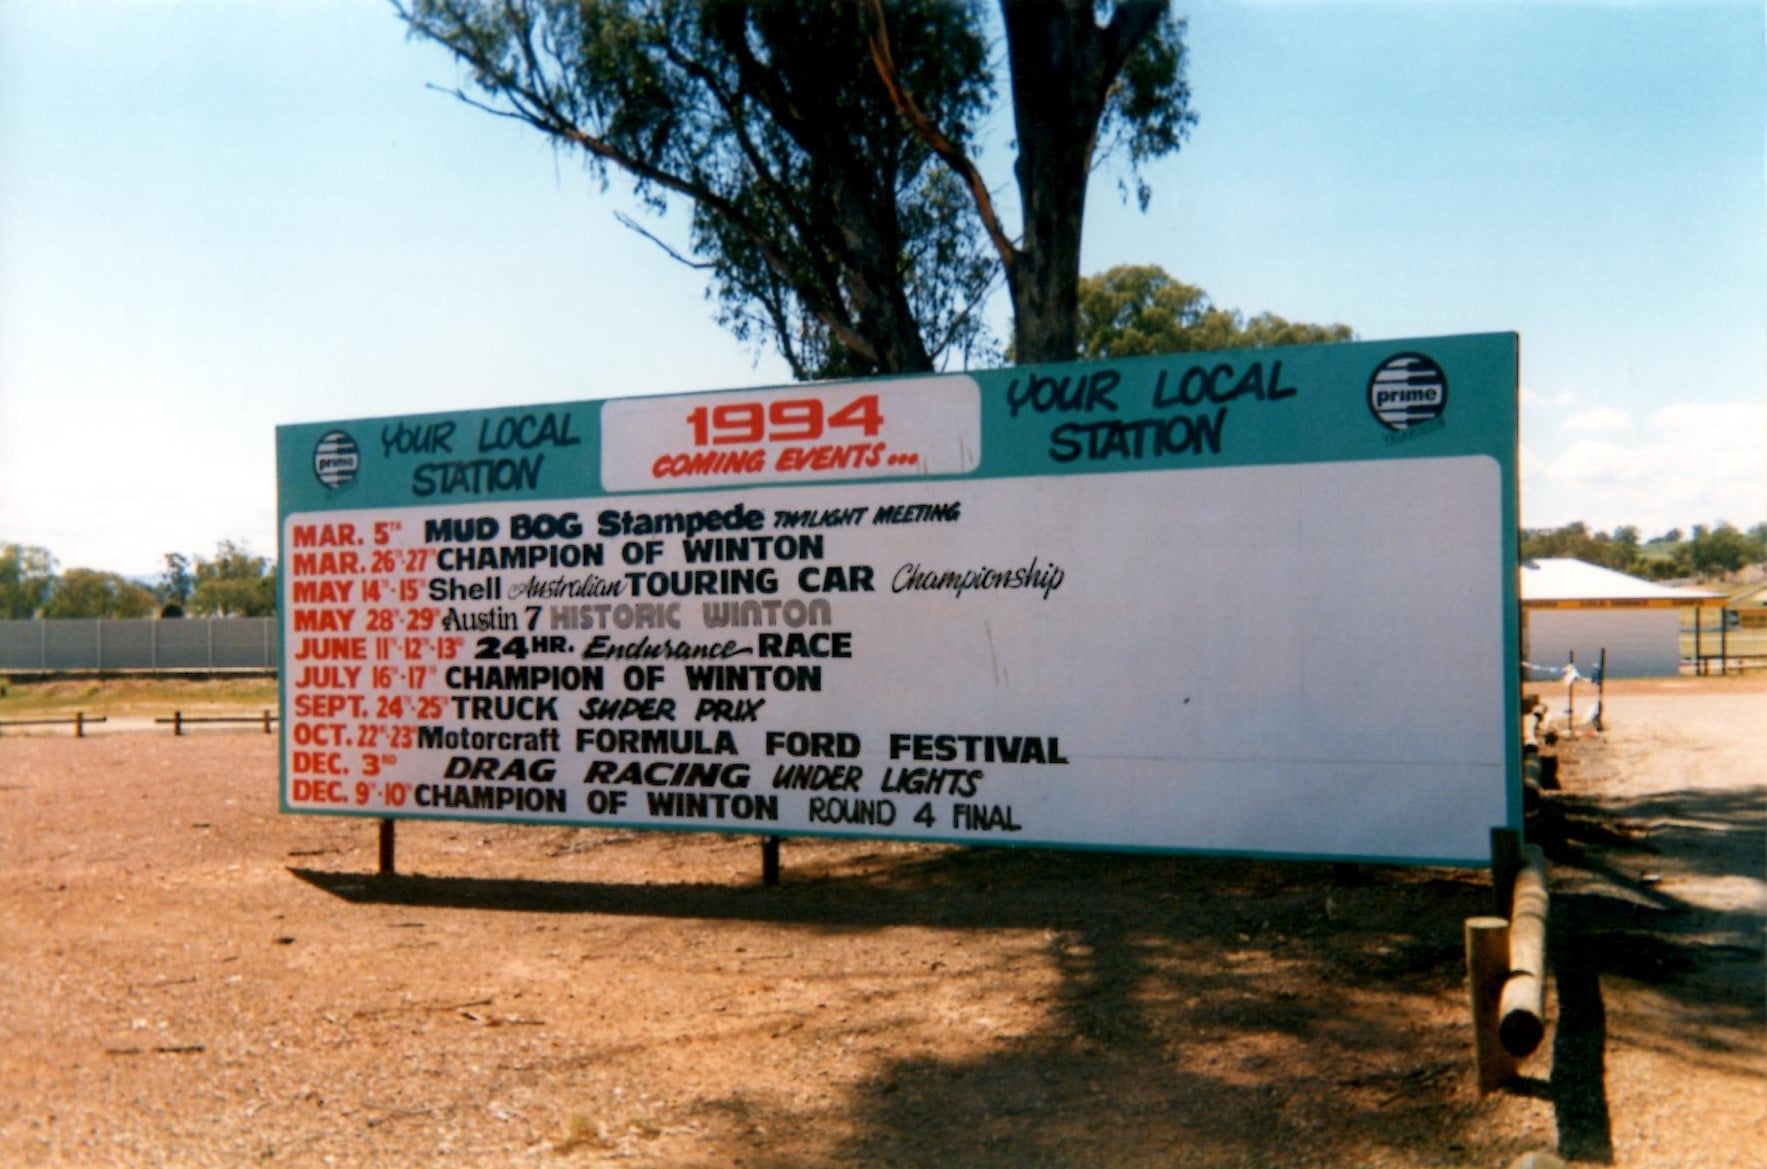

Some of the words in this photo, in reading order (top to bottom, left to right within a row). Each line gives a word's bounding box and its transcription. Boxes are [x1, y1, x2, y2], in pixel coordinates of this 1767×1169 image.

[1005, 369, 1121, 417] YOUR
[1152, 360, 1297, 407] LOCAL
[1376, 388, 1437, 406] prime
[381, 421, 456, 458] YOUR
[478, 412, 582, 454] LOCAL
[686, 394, 885, 446] 1994
[1048, 407, 1228, 462] STATION
[411, 454, 545, 497] STATION
[652, 449, 765, 478] COMING
[292, 523, 364, 547] MAR.
[425, 516, 499, 543] MUD
[510, 511, 583, 541] BOG
[597, 503, 766, 538] Stampede
[773, 506, 868, 529] TWILIGHT
[873, 501, 962, 525] MEETING
[292, 550, 366, 576] MAR.
[437, 543, 604, 571] CHAMPION
[621, 540, 664, 566] OF
[684, 535, 824, 563] WINTON
[292, 579, 354, 603] MAY
[429, 576, 501, 601] Shell
[507, 574, 627, 600] Australian
[625, 568, 778, 599] TOURING
[799, 565, 876, 593] CAR
[891, 556, 1065, 600] Championship
[293, 608, 355, 632] MAY
[441, 606, 518, 631] Austin
[525, 606, 542, 631] 7
[550, 602, 681, 631] HISTORIC
[703, 598, 832, 630] WINTON
[295, 637, 367, 660] JUNE
[582, 634, 753, 662] Endurance
[758, 632, 853, 658] RACE
[295, 665, 363, 690] JULY
[445, 665, 603, 691] CHAMPION
[623, 665, 665, 691] OF
[686, 665, 823, 692] WINTON
[293, 694, 369, 718] SEPT.
[451, 696, 559, 721] TRUCK
[579, 697, 676, 722] SUPER
[694, 698, 767, 723] PRIX
[293, 723, 353, 747] OCT.
[417, 726, 560, 751] Motorcraft
[576, 728, 739, 756] FORMULA
[765, 731, 862, 759] FORD
[889, 734, 1069, 764] FESTIVAL
[292, 751, 349, 775] DEC.
[443, 756, 557, 782] DRAG
[583, 761, 751, 789] RACING
[772, 764, 864, 792] UNDER
[880, 766, 985, 798] LIGHTS
[292, 779, 349, 803] DEC.
[414, 784, 567, 813] CHAMPION
[587, 790, 627, 815] OF
[647, 792, 779, 821] WINTON
[808, 797, 897, 827] ROUND
[913, 802, 936, 829] 4
[953, 803, 1023, 832] FINAL
